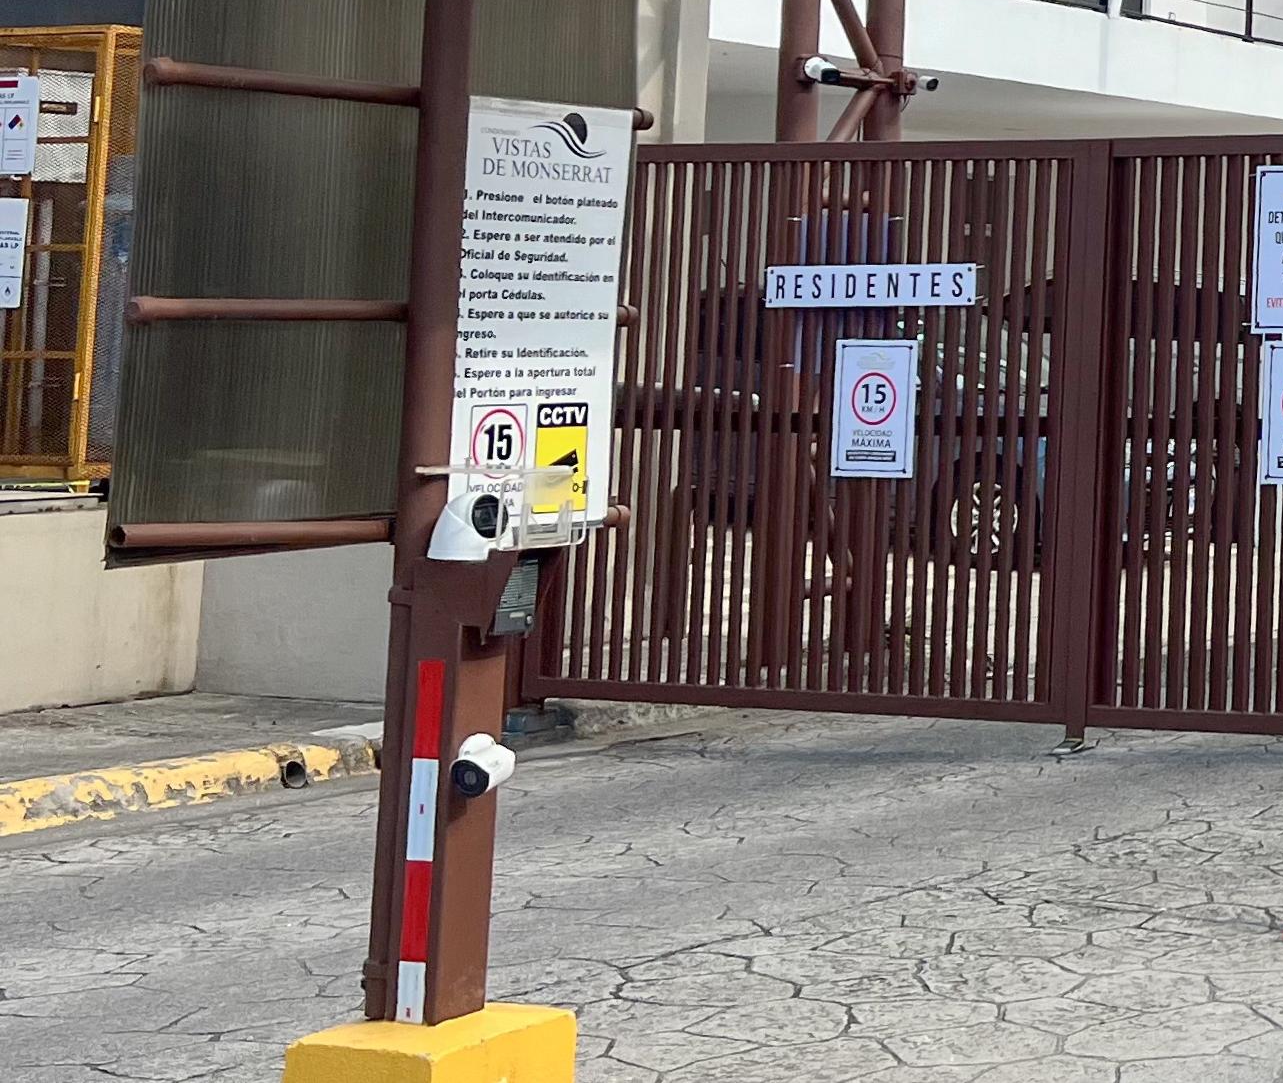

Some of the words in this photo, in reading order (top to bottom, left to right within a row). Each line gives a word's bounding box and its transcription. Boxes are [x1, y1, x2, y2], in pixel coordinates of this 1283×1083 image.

[492, 136, 552, 159] VISTAS
[482, 157, 506, 177] DE
[511, 160, 613, 184] MONSERRAT
[476, 189, 524, 203] Presione
[533, 194, 542, 204] el
[576, 197, 618, 208] plateado
[481, 210, 577, 225] Intercomunicador.
[473, 229, 511, 243] Espere
[514, 233, 521, 242] a
[524, 233, 541, 242] ser
[543, 234, 587, 245] atendido
[589, 237, 604, 247] por
[607, 237, 616, 246] el
[497, 250, 511, 261] de
[514, 250, 568, 264] Seguridad.
[470, 269, 514, 283] Coloque
[517, 271, 529, 280] su
[603, 275, 614, 283] en
[775, 272, 964, 300] RESIDENTES
[469, 289, 498, 301] porta
[468, 308, 505, 321] Espere
[507, 311, 514, 320] a
[516, 311, 536, 322] que
[539, 312, 551, 320] se
[554, 310, 595, 321] autorice
[598, 312, 609, 321] su
[465, 347, 498, 359] Retire
[501, 349, 513, 358] su
[464, 367, 501, 381] Espere
[504, 370, 512, 379] a
[514, 368, 524, 378] la
[527, 367, 571, 380] apertura
[574, 366, 596, 377] total
[509, 388, 533, 400] para
[536, 386, 577, 399] ingresar
[861, 383, 887, 405] 15
[484, 424, 512, 461] 15
[539, 406, 587, 426] CCTV
